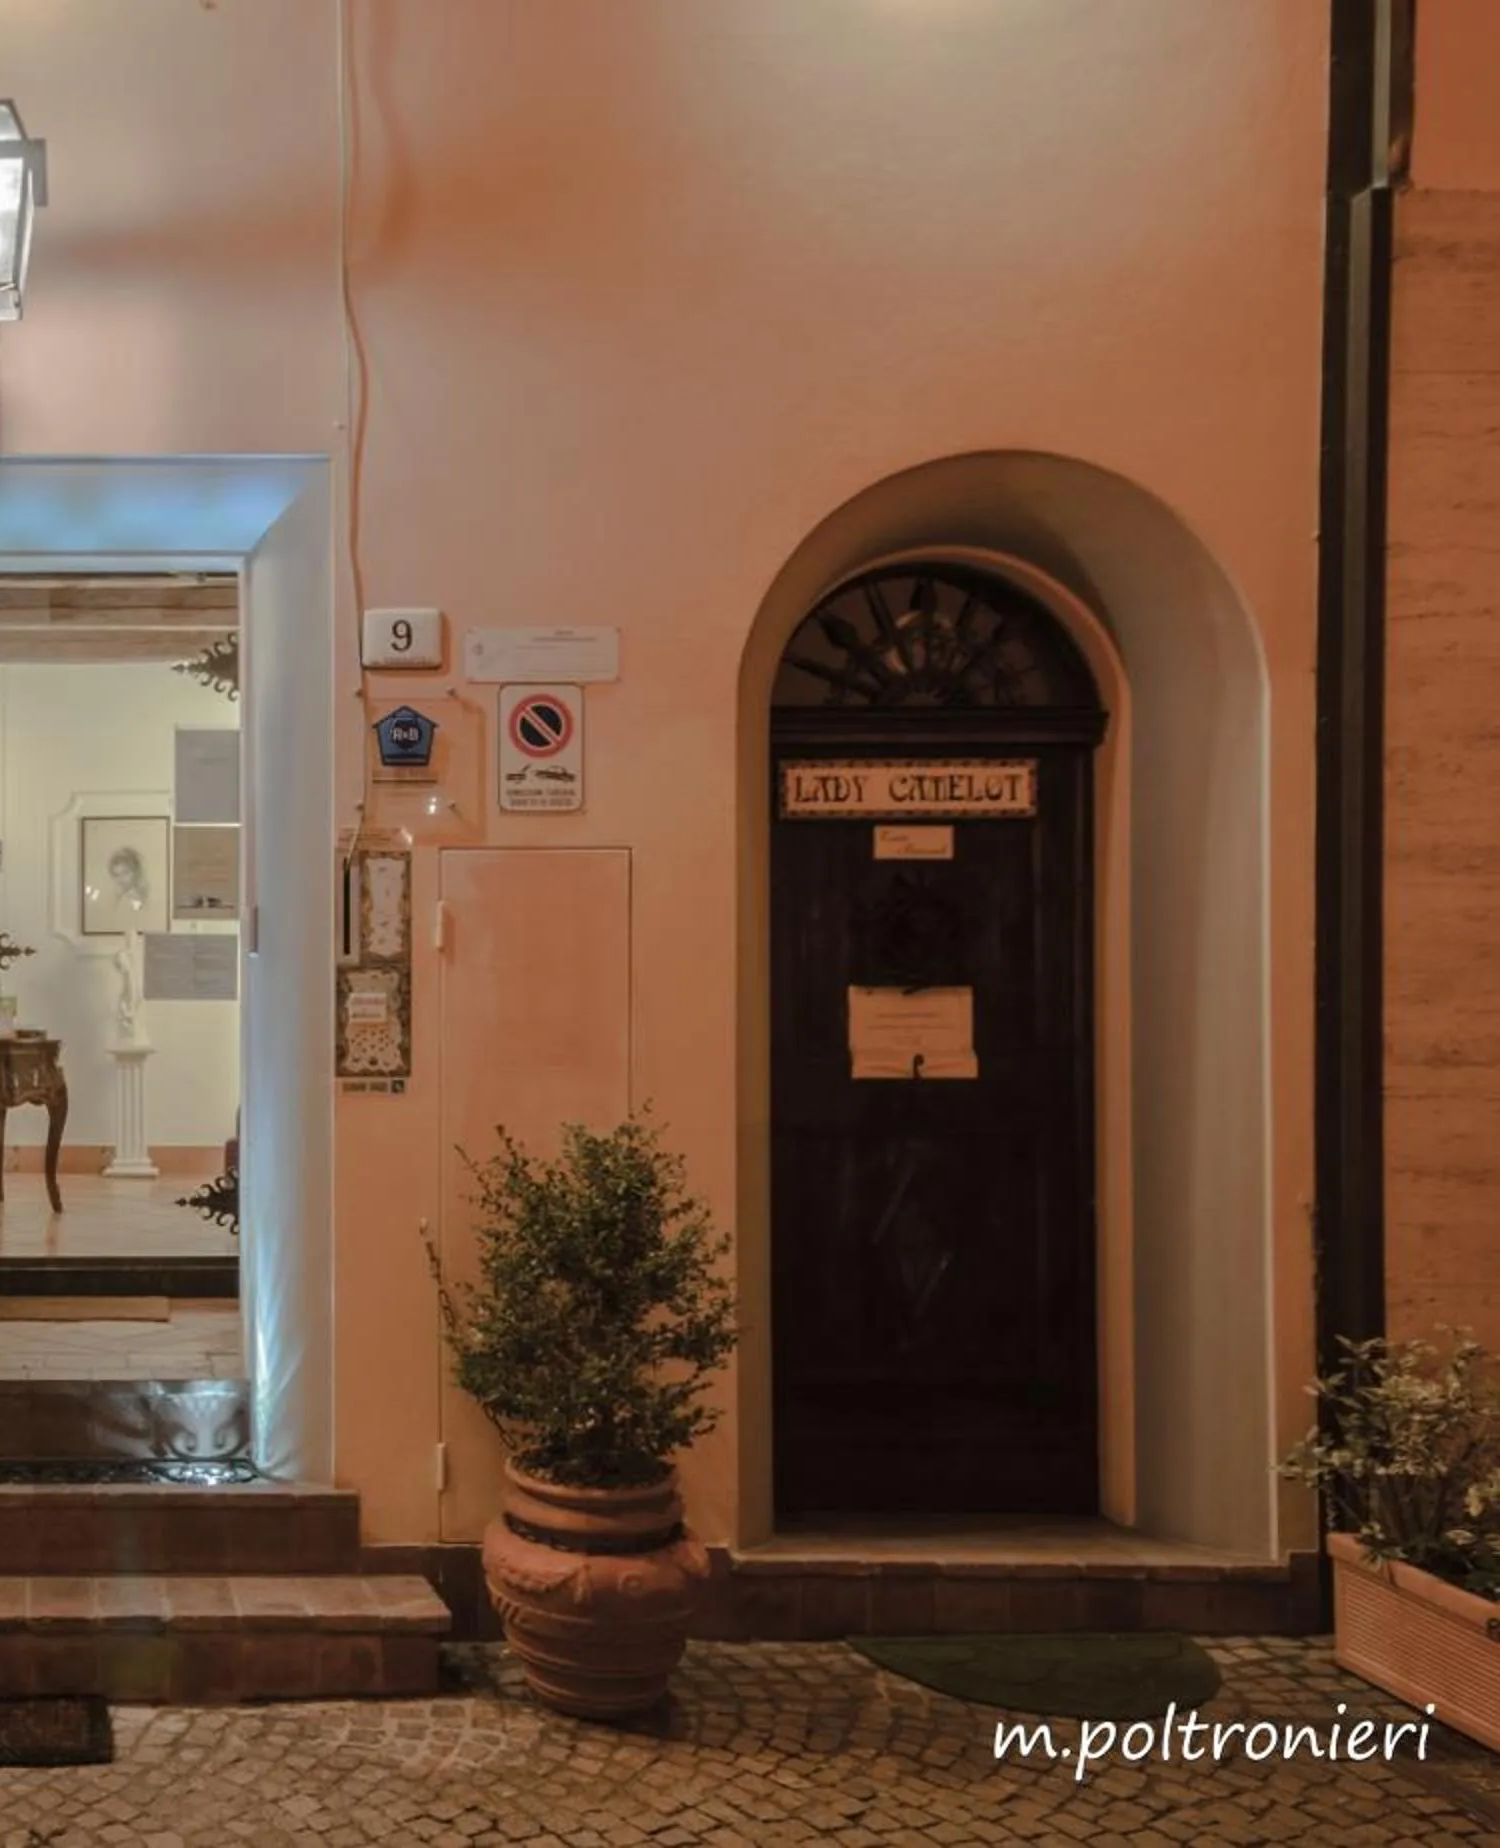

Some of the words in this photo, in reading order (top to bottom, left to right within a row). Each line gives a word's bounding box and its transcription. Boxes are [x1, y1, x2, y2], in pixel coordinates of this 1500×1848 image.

[391, 619, 413, 651] 9
[794, 775, 868, 803] LADY
[888, 774, 1024, 803] CAMELOT
